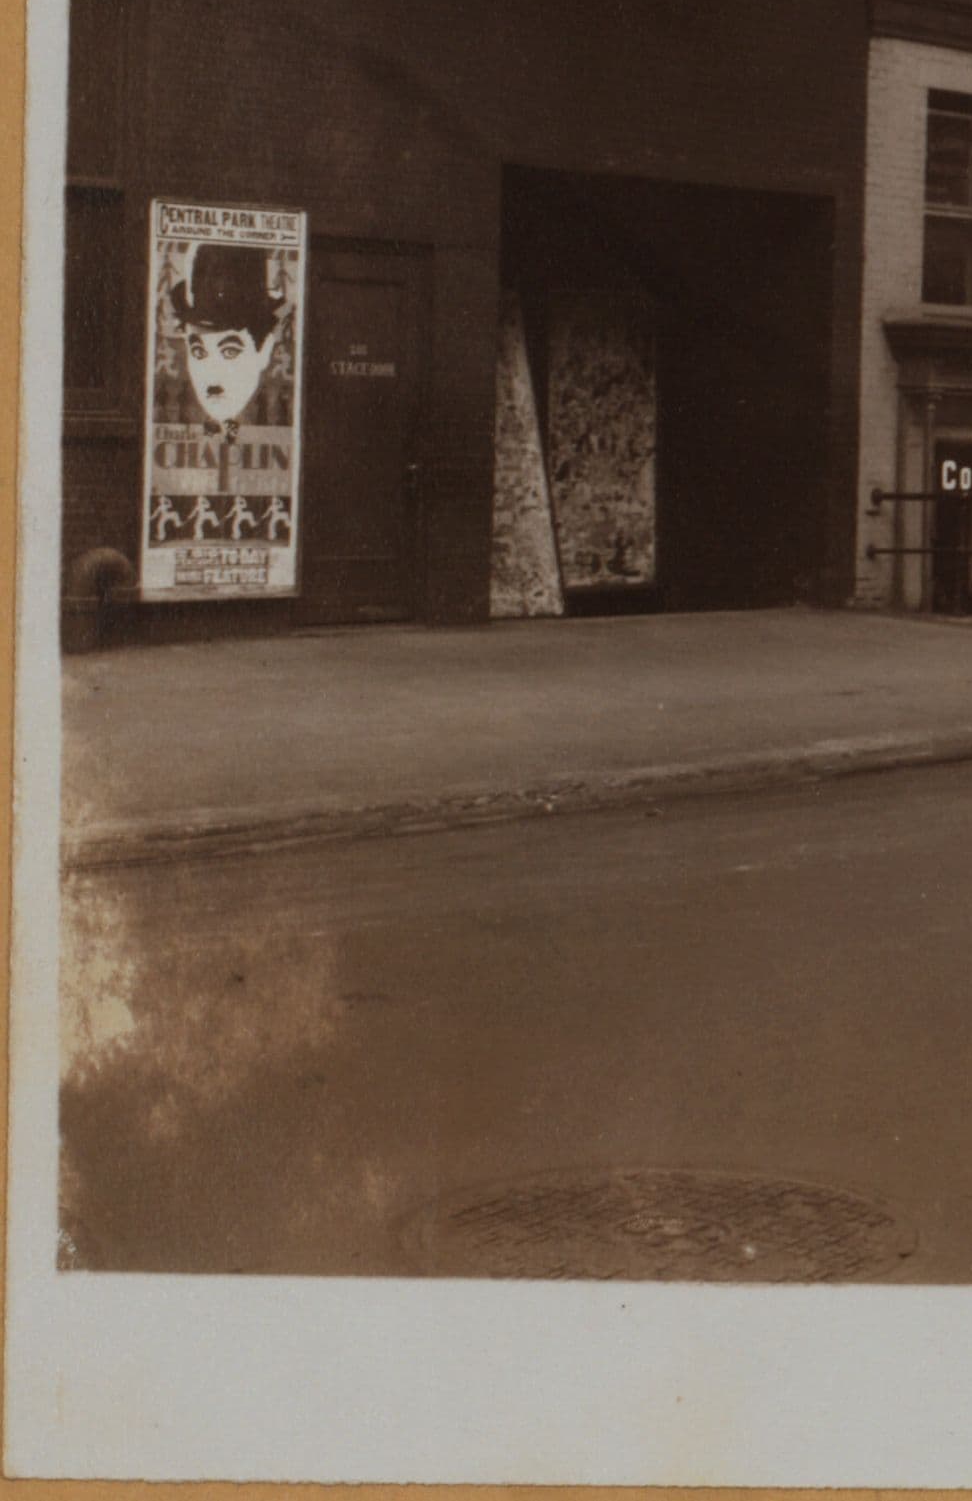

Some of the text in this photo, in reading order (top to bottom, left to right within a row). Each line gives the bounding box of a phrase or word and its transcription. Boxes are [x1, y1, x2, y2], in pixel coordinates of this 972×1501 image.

[160, 205, 218, 234] CENTRAL
[221, 211, 256, 229] PARK
[153, 441, 291, 486] CHAPLIN
